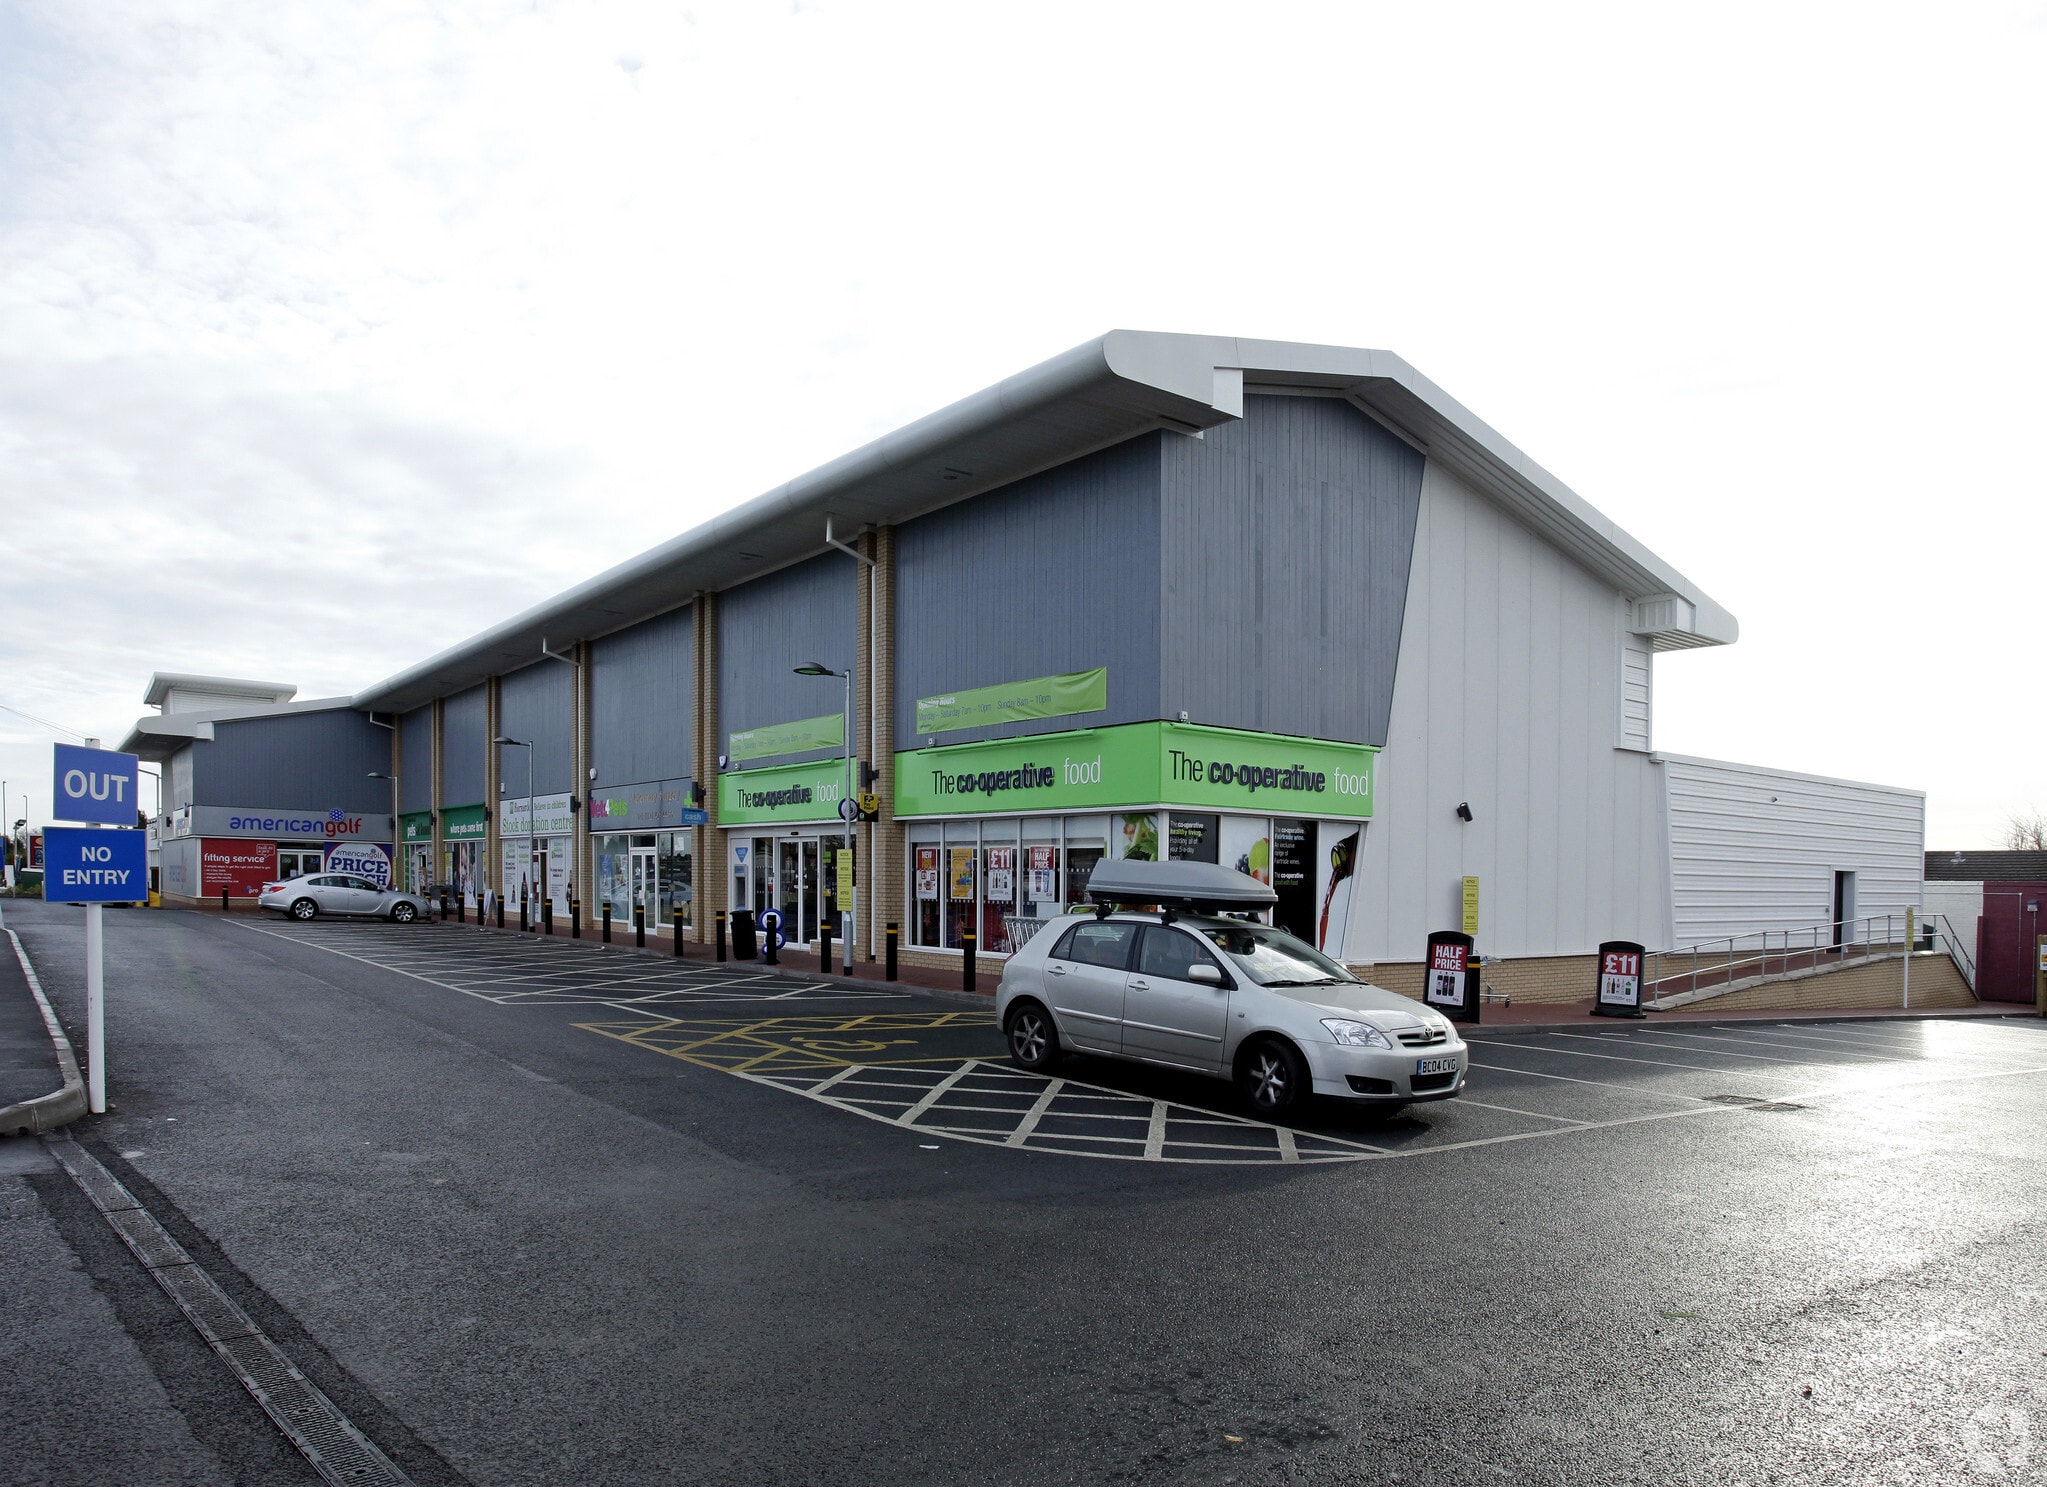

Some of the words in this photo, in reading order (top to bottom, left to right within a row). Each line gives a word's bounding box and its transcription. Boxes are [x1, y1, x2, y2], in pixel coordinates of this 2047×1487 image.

[978, 703, 992, 714] 10pm
[997, 700, 1016, 711] Sunday
[1017, 697, 1029, 707] 8am
[1035, 694, 1052, 705] 10pm
[931, 769, 955, 795] The
[956, 762, 1055, 797] co-operative
[1063, 754, 1101, 785] food
[1168, 750, 1204, 782] The
[1208, 761, 1326, 792] co-operative
[1333, 766, 1369, 796] food
[64, 769, 129, 802] OUT
[737, 788, 752, 809] The
[752, 783, 813, 811] co-operative
[816, 779, 839, 802] food
[502, 817, 519, 833] Stock
[685, 813, 702, 821] cash
[230, 817, 362, 838] americangolf
[82, 846, 112, 862] NO
[204, 853, 230, 864] fitting
[232, 855, 265, 863] service
[335, 849, 383, 859] americangolf
[990, 849, 1011, 869] £11
[1034, 852, 1050, 861] HALF
[330, 856, 388, 874] PRICE
[1034, 861, 1049, 869] PRICE
[63, 869, 130, 885] ENTRY
[1435, 945, 1463, 959] HALF
[1434, 957, 1462, 971] PRICE
[1605, 954, 1637, 974] £11
[1442, 1058, 1456, 1071] CVG
